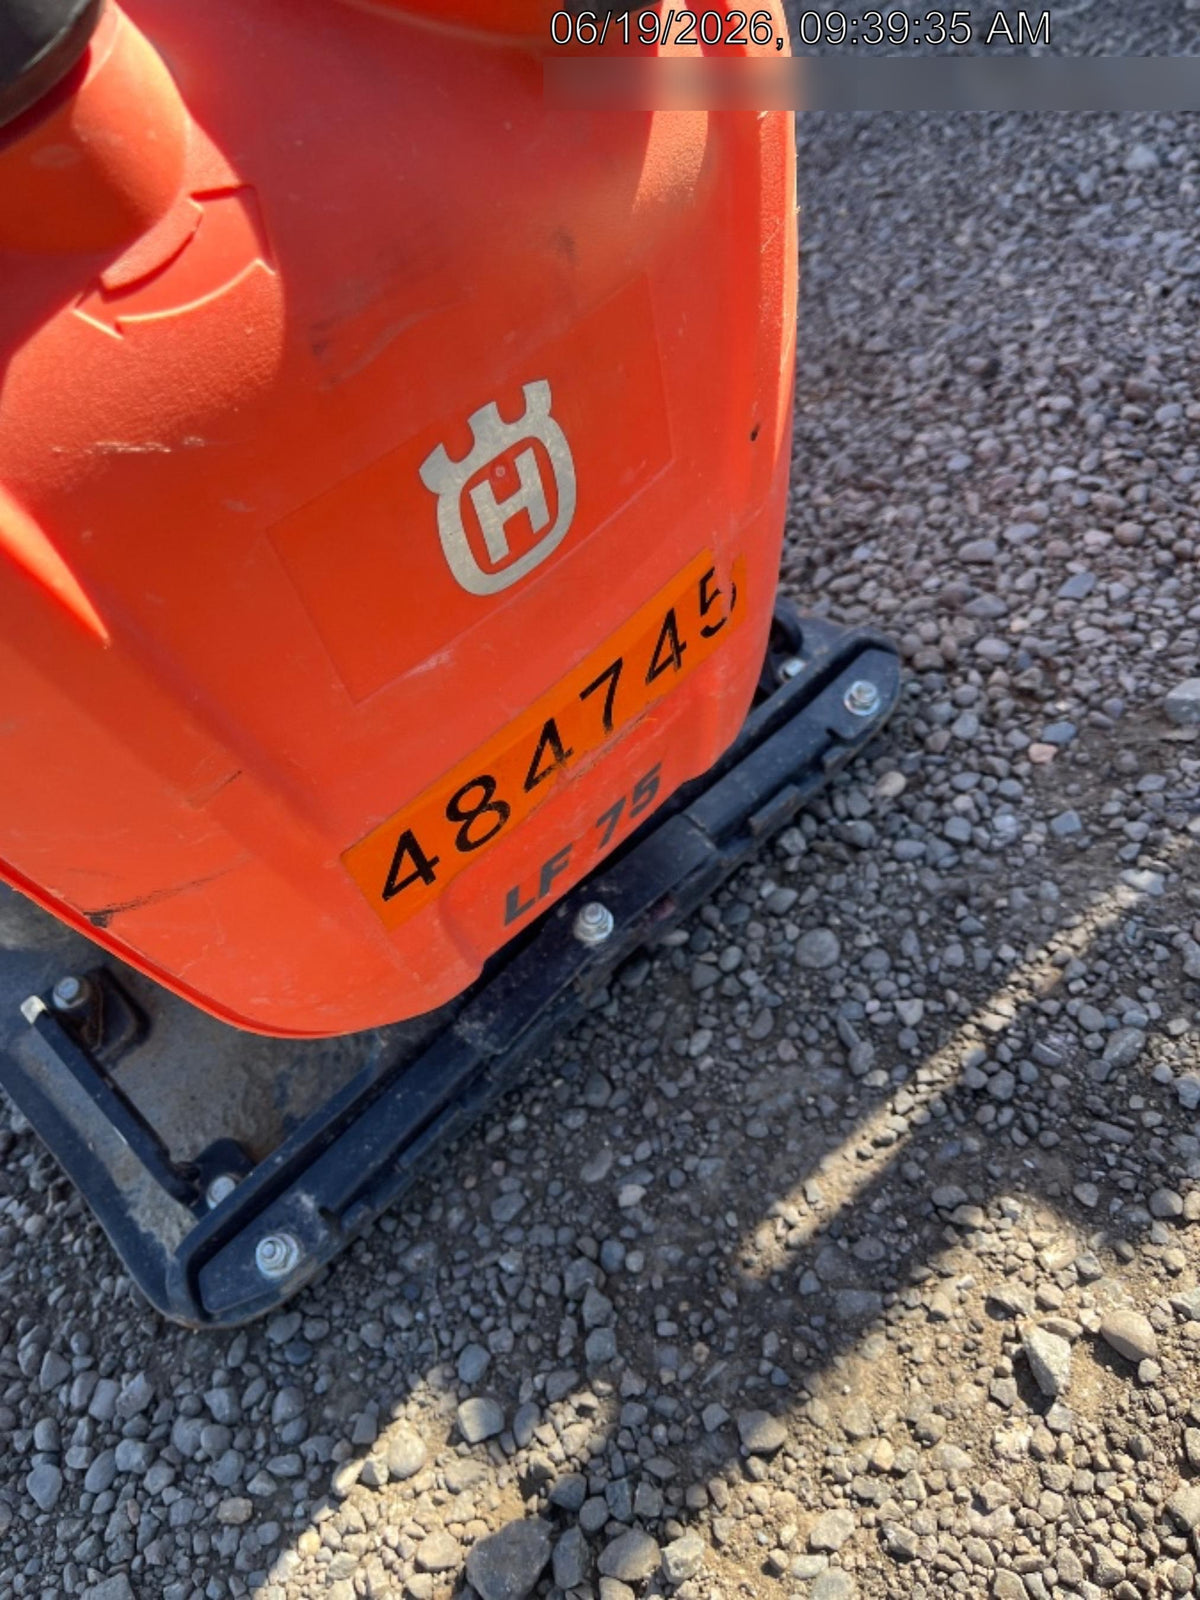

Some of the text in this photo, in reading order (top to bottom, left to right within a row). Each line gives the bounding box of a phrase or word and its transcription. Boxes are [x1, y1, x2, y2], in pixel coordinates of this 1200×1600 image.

[469, 447, 550, 565] H
[381, 566, 737, 902] 484745
[504, 762, 662, 927] LF 75
